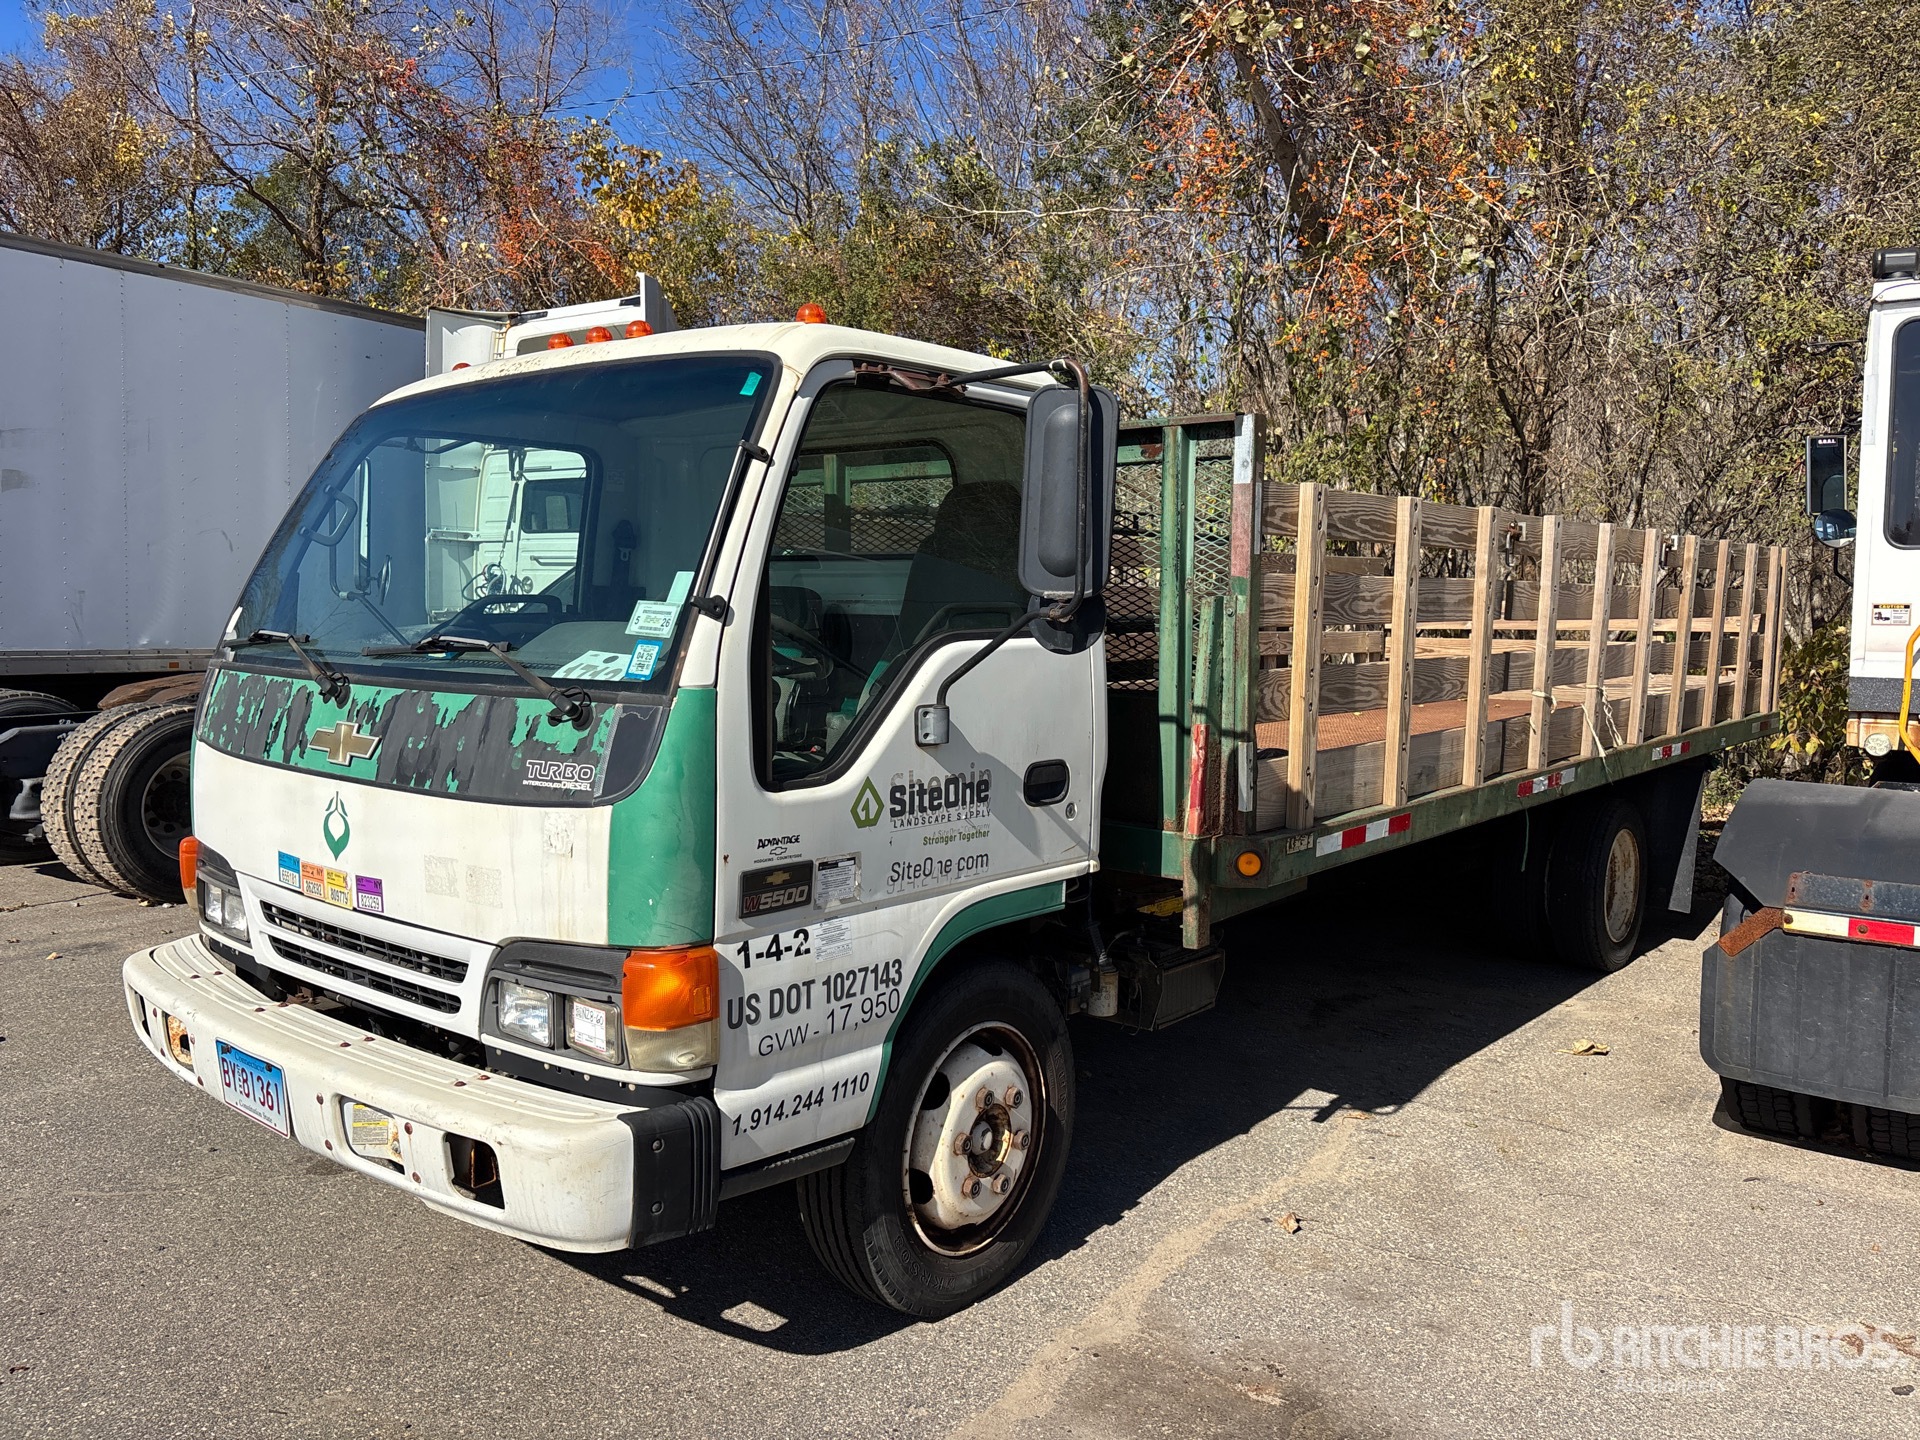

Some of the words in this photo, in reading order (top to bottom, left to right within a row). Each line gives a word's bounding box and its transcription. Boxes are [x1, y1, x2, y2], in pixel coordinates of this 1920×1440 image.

[660, 617, 671, 628] 26
[526, 759, 596, 783] TURBO
[522, 779, 561, 789] INTERCOOLED
[561, 781, 592, 791] DIESEL
[889, 776, 990, 818] SiteOne
[893, 812, 952, 829] LANDSCAPE
[757, 835, 801, 850] ADVANTAGE
[922, 833, 957, 846] Stronger
[958, 829, 990, 843] Together
[743, 885, 809, 914] W5500
[736, 928, 811, 969] 1-4-2
[727, 992, 762, 1030] US
[769, 978, 816, 1022] DOT
[821, 958, 903, 1005] 1027143
[758, 1023, 809, 1057] GVW
[826, 988, 900, 1034] 17,950
